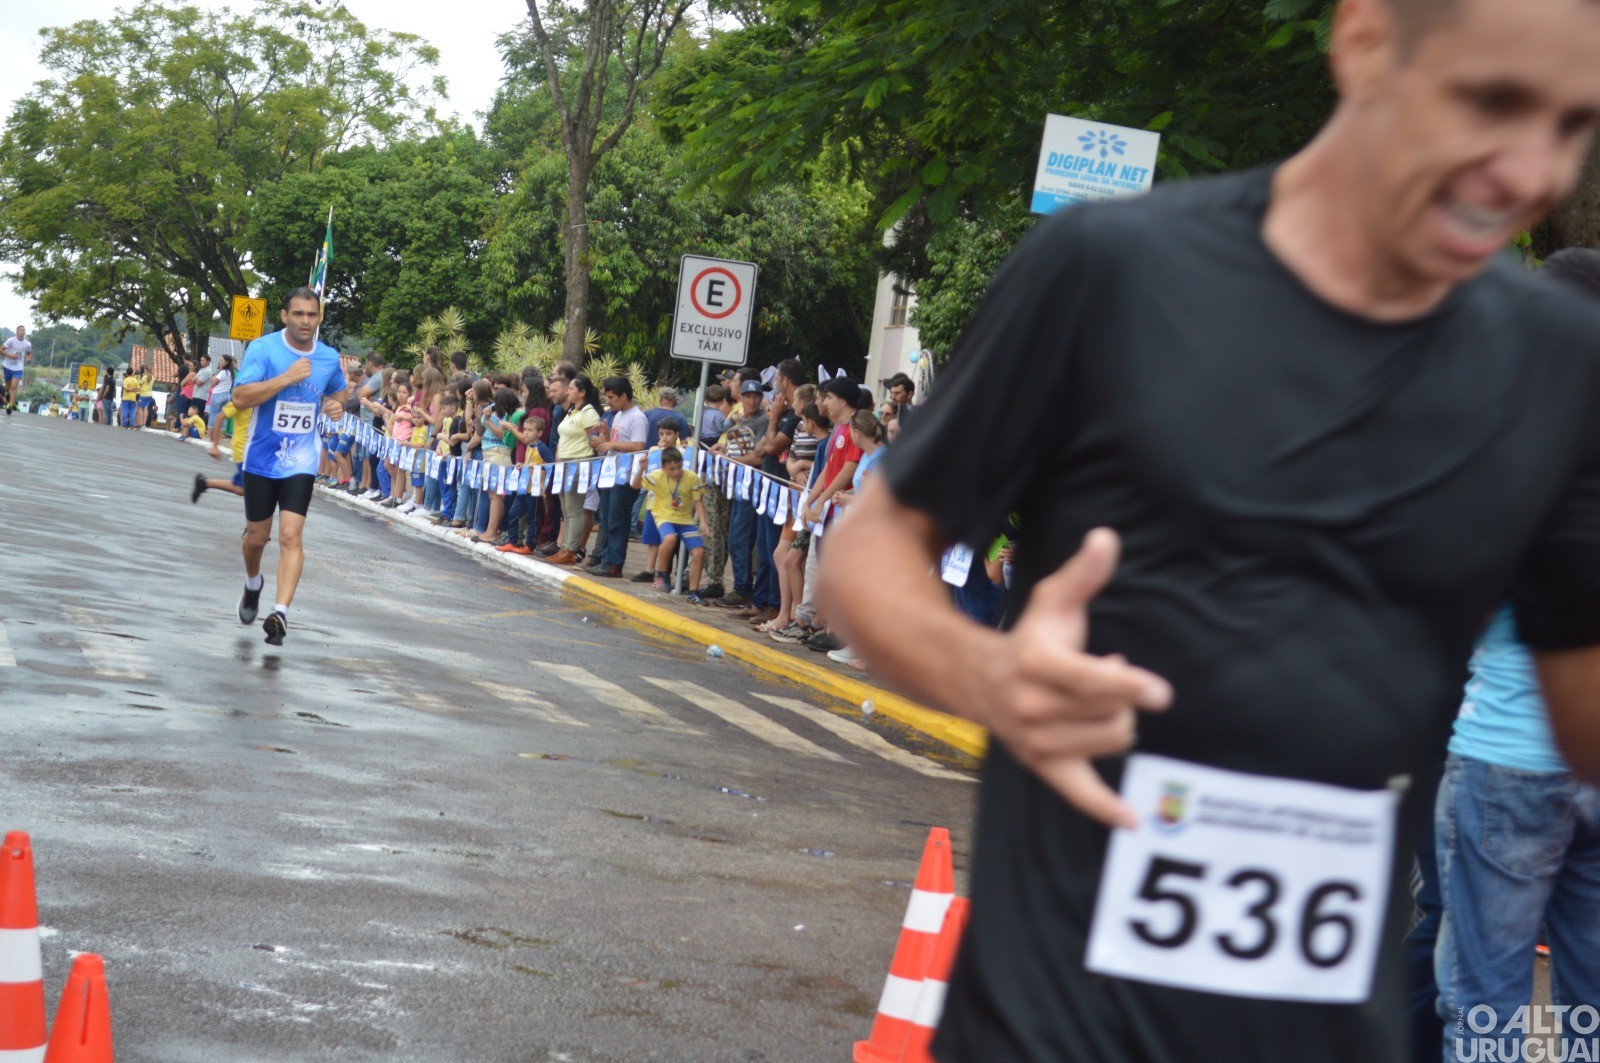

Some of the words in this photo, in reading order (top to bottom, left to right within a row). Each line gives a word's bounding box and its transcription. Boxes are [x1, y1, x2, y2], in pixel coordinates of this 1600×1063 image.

[1045, 167, 1079, 181] PROVEDOR
[1080, 173, 1100, 184] LEGAL
[1111, 179, 1143, 191] INTERNET
[1046, 151, 1118, 178] DIGIPLAN
[1120, 164, 1149, 183] NET
[706, 278, 725, 307] E
[680, 322, 742, 340] EXCLUSIVO
[698, 337, 722, 352] TÁXI
[277, 413, 312, 430] 576
[1126, 852, 1363, 970] 536
